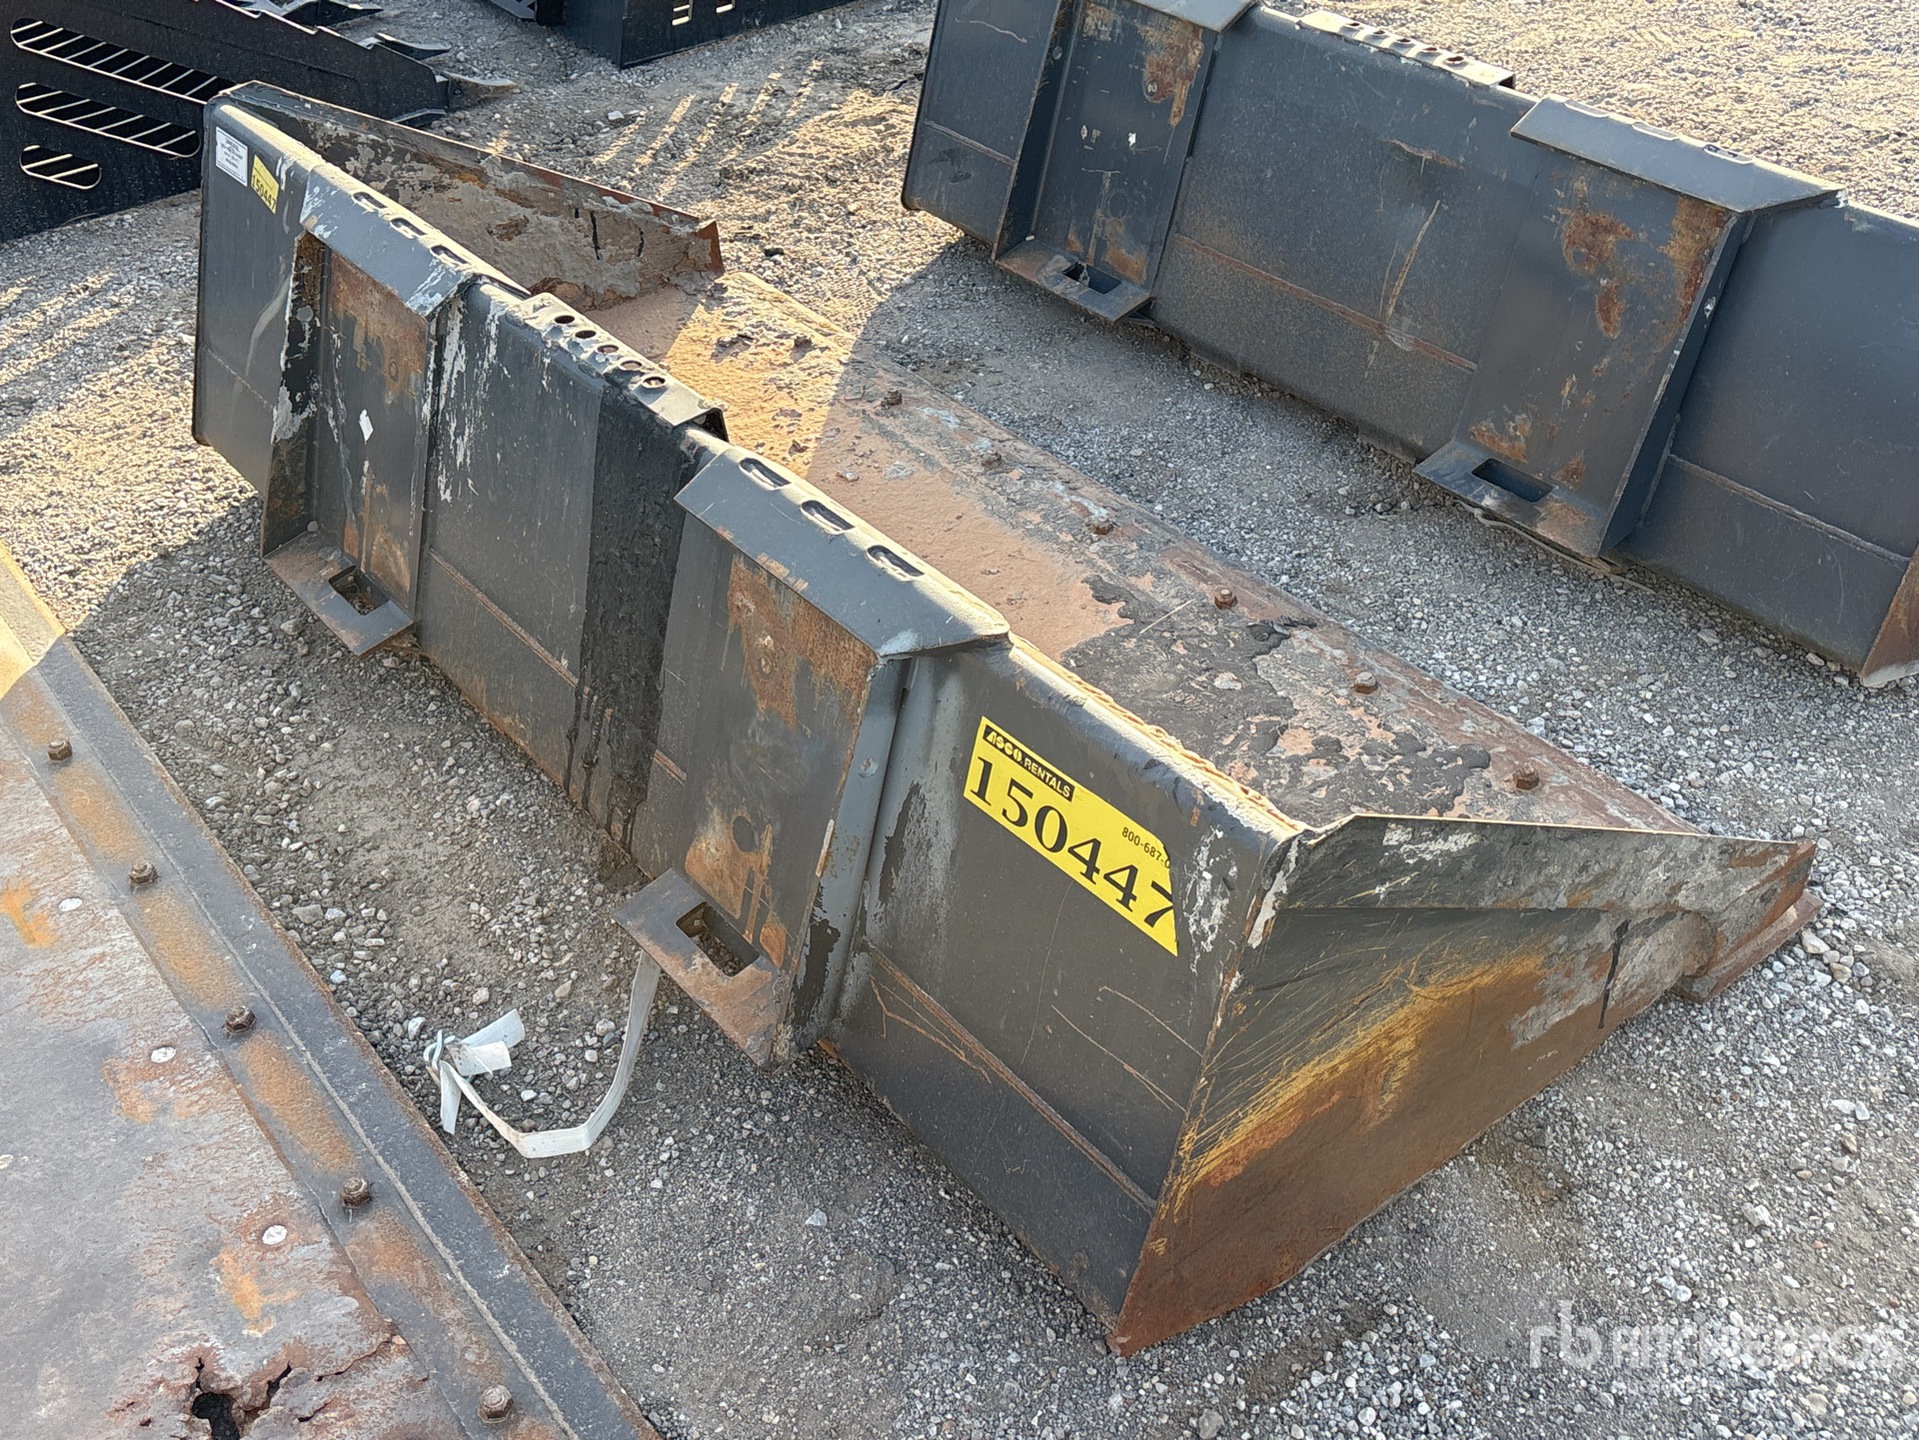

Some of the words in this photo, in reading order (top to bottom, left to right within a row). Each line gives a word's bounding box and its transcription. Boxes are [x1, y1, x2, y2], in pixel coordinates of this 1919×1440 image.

[252, 175, 276, 210] 150447
[1024, 757, 1071, 799] RENTALS
[970, 756, 1174, 928] 150447
